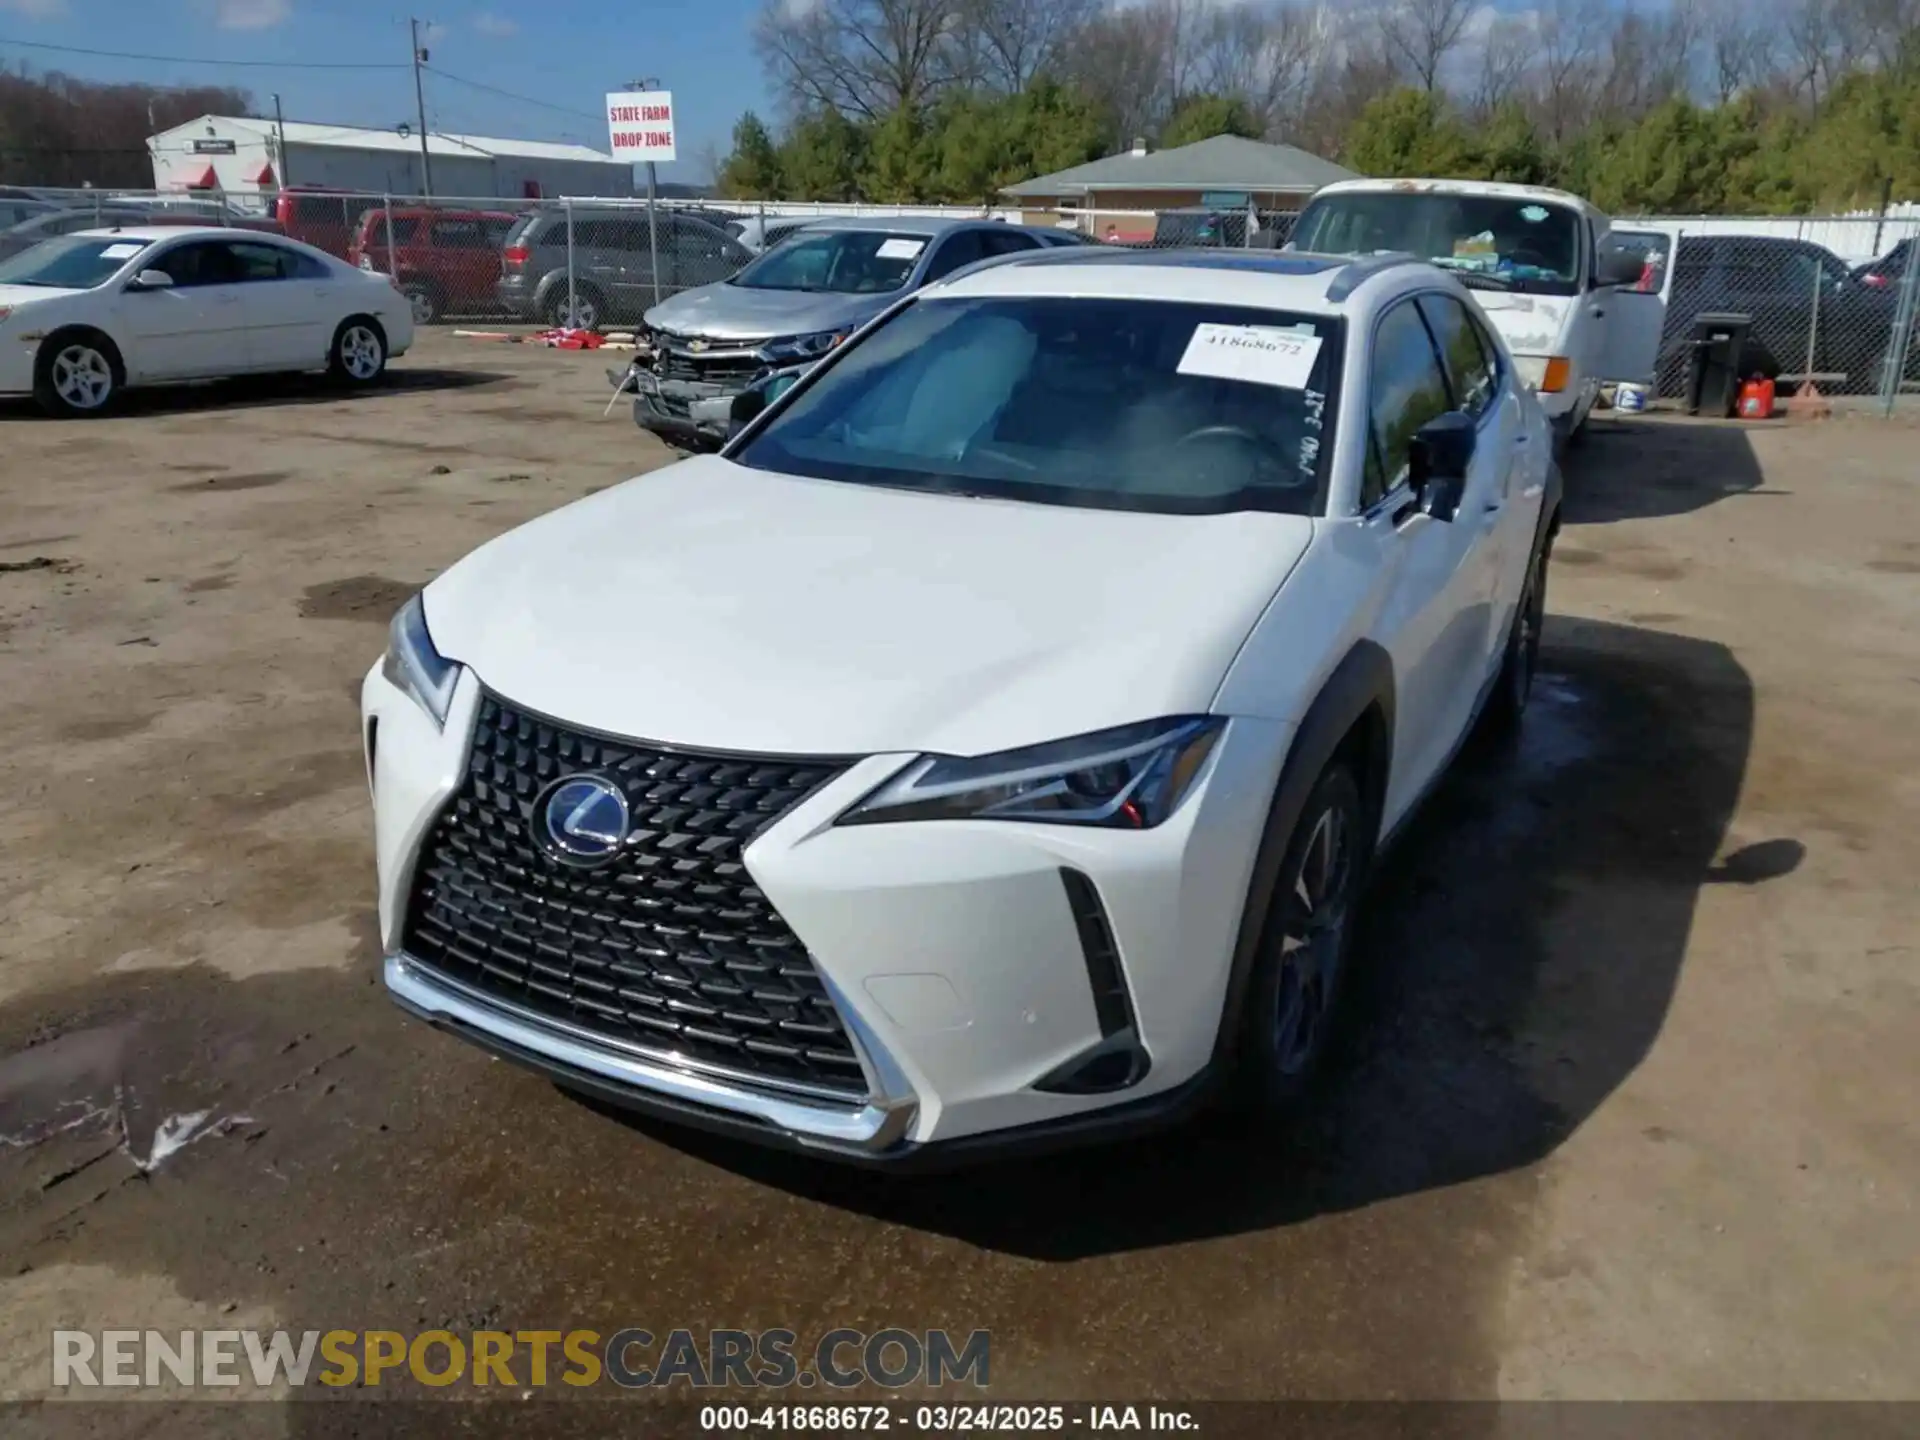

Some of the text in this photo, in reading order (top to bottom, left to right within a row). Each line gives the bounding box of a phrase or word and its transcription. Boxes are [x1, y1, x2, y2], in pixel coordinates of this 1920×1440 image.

[611, 105, 670, 122] STATE FARM
[613, 131, 672, 148] DROP ZONE
